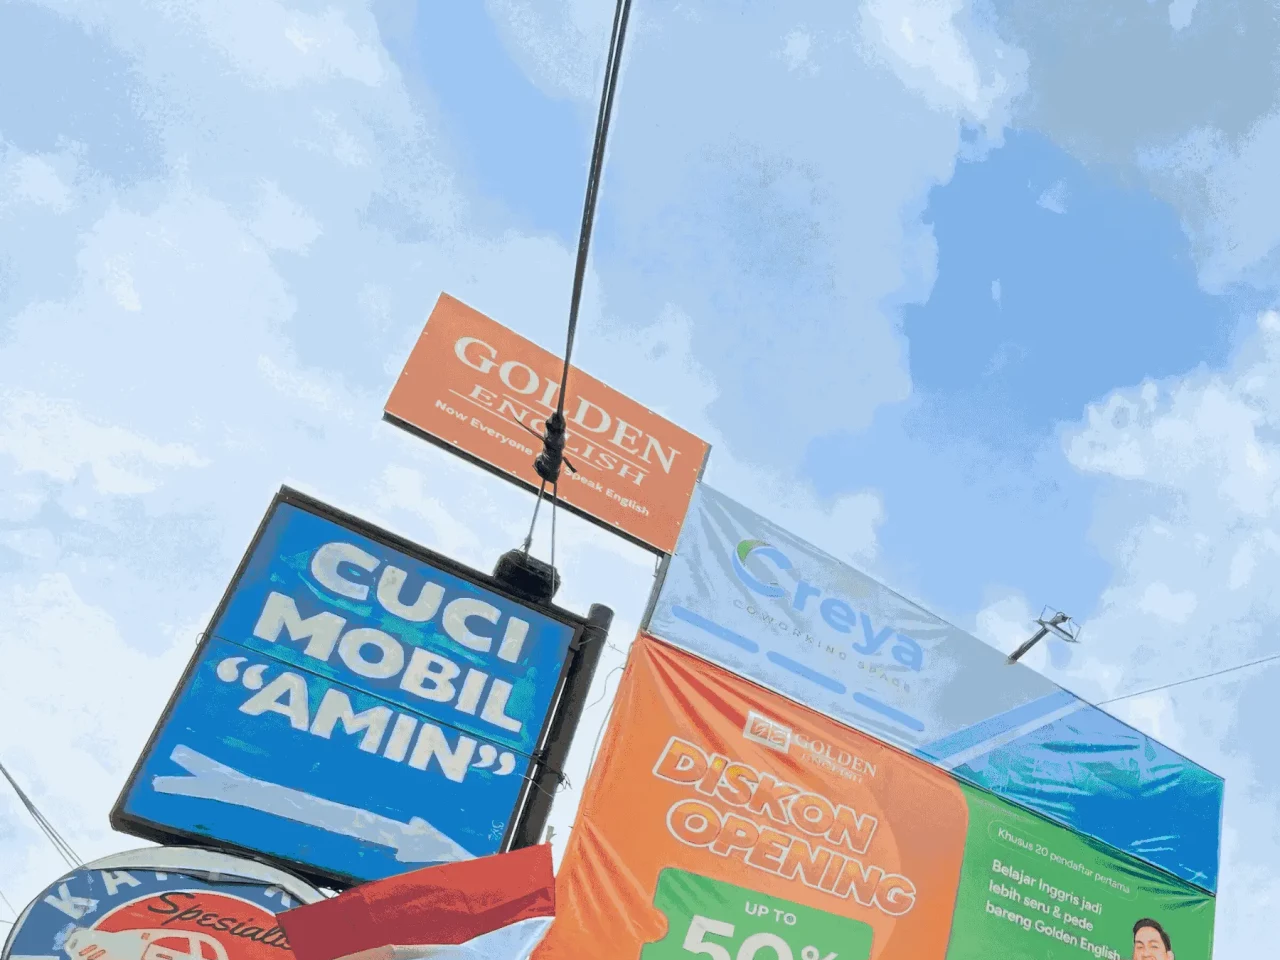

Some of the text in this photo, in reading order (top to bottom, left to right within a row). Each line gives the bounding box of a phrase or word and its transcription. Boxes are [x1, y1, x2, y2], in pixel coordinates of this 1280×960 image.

[435, 399, 533, 456] Now Everyone
[454, 336, 682, 475] GOLDEN
[564, 466, 650, 517] Speak English
[311, 542, 530, 663] CUCI
[732, 540, 923, 672] Creya
[253, 592, 523, 733] MOBIL
[215, 656, 516, 783] “AMIN”
[794, 734, 877, 777] GOLDEN
[652, 736, 878, 854] DISKON
[666, 799, 916, 916] OPENING
[992, 858, 1103, 916] Belajar Inggris jadi
[998, 827, 1131, 895] Khusus 20 pendaftar pertama
[745, 901, 797, 926] UP TO
[985, 900, 1032, 930] bareng
[1034, 920, 1078, 947] Golden
[988, 879, 1094, 932] lebih seru & pede
